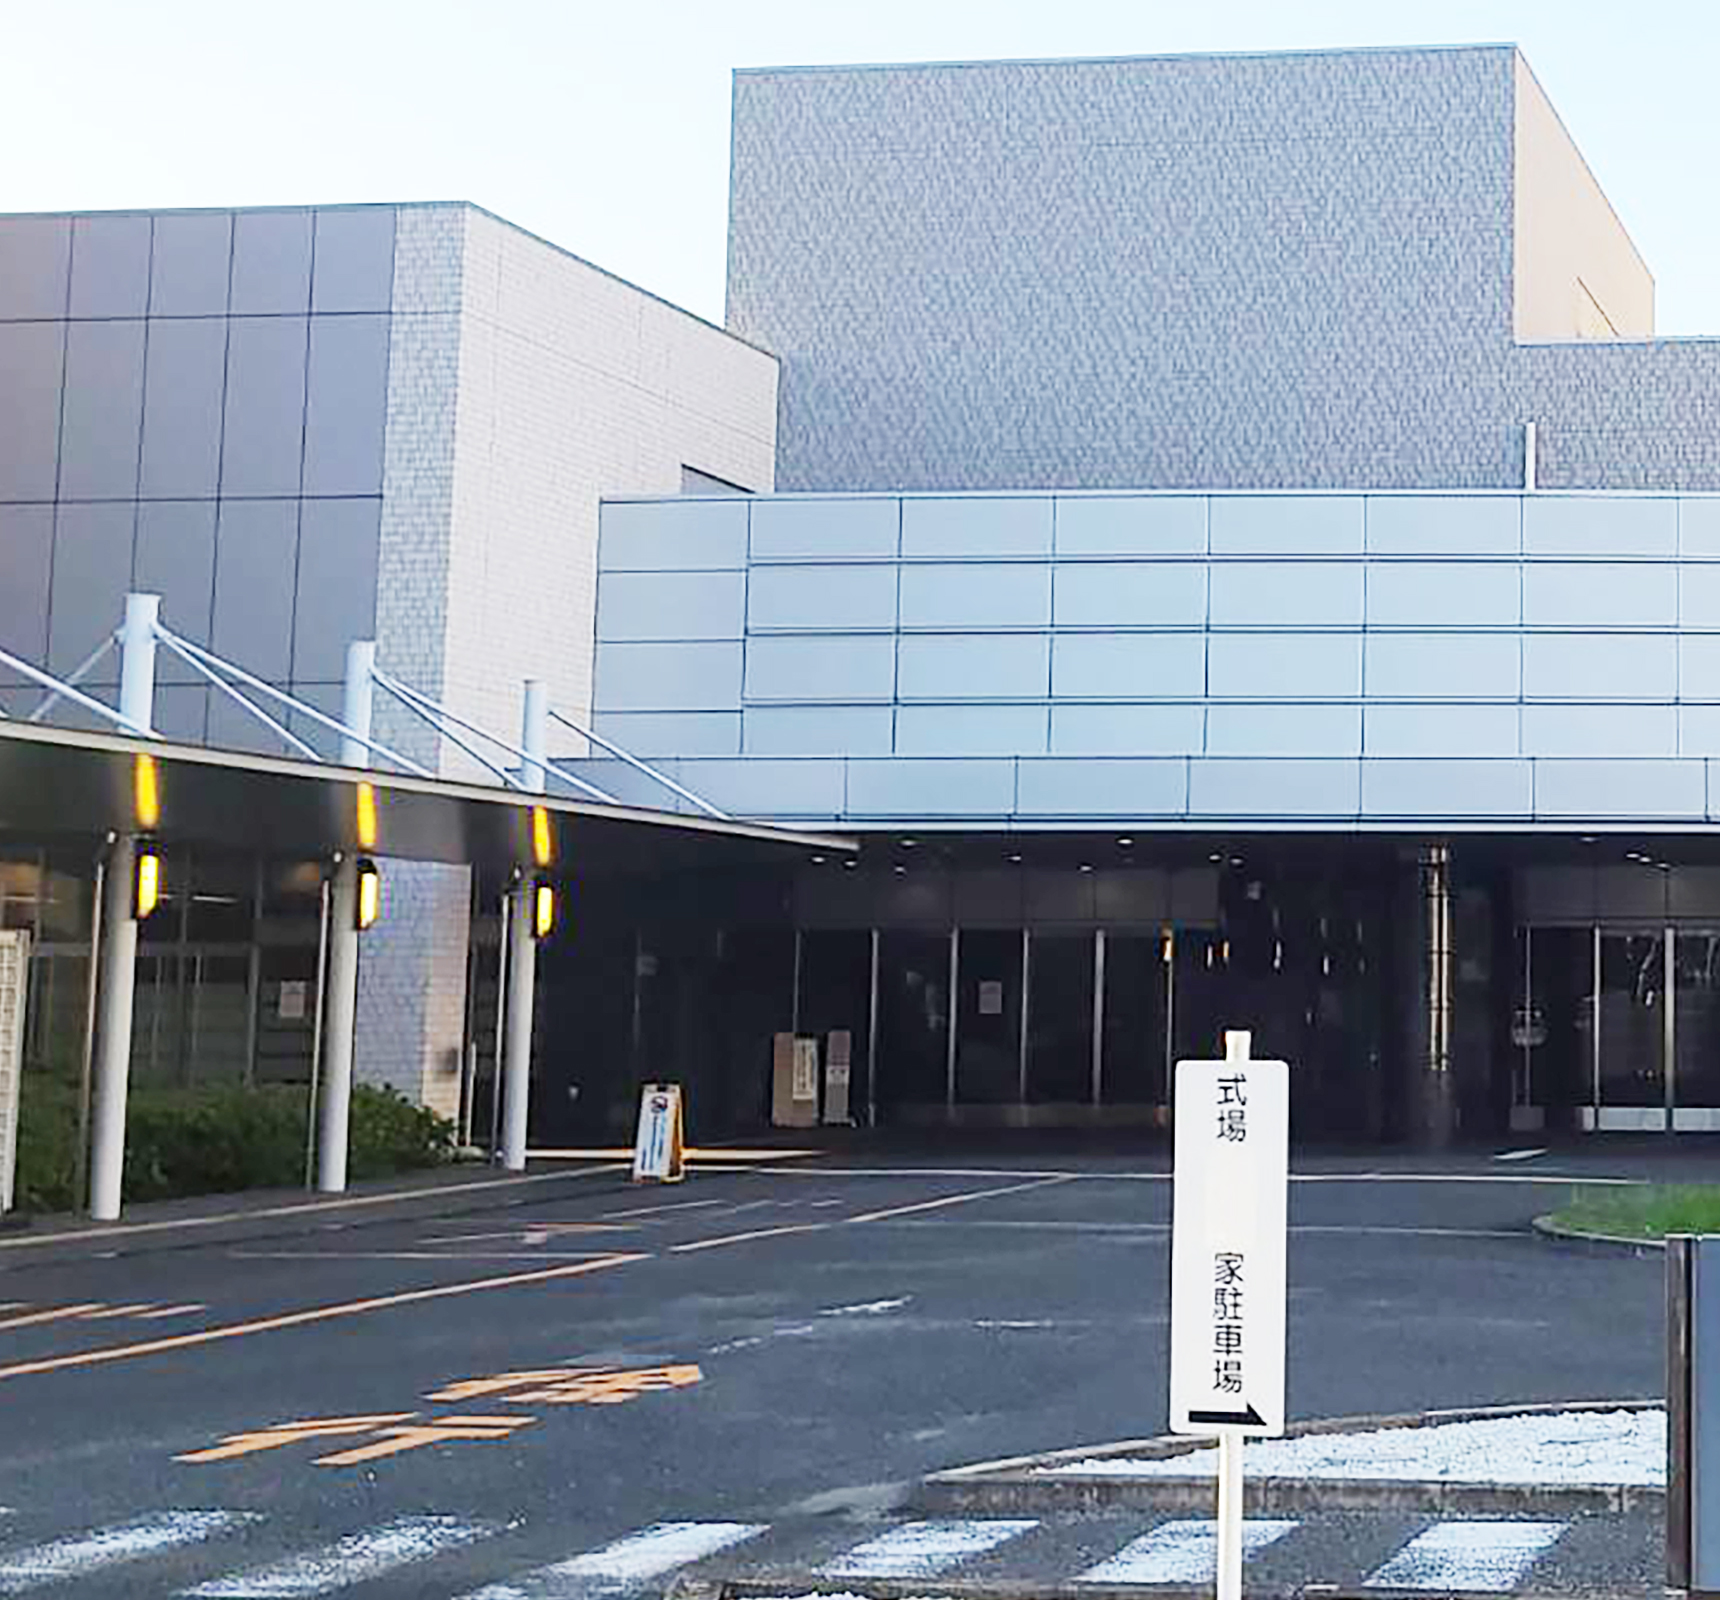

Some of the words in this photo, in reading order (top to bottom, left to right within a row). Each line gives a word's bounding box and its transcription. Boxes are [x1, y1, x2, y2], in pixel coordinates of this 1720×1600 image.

[1216, 1074, 1247, 1143] 式場
[1213, 1252, 1244, 1393] 家駐車場
